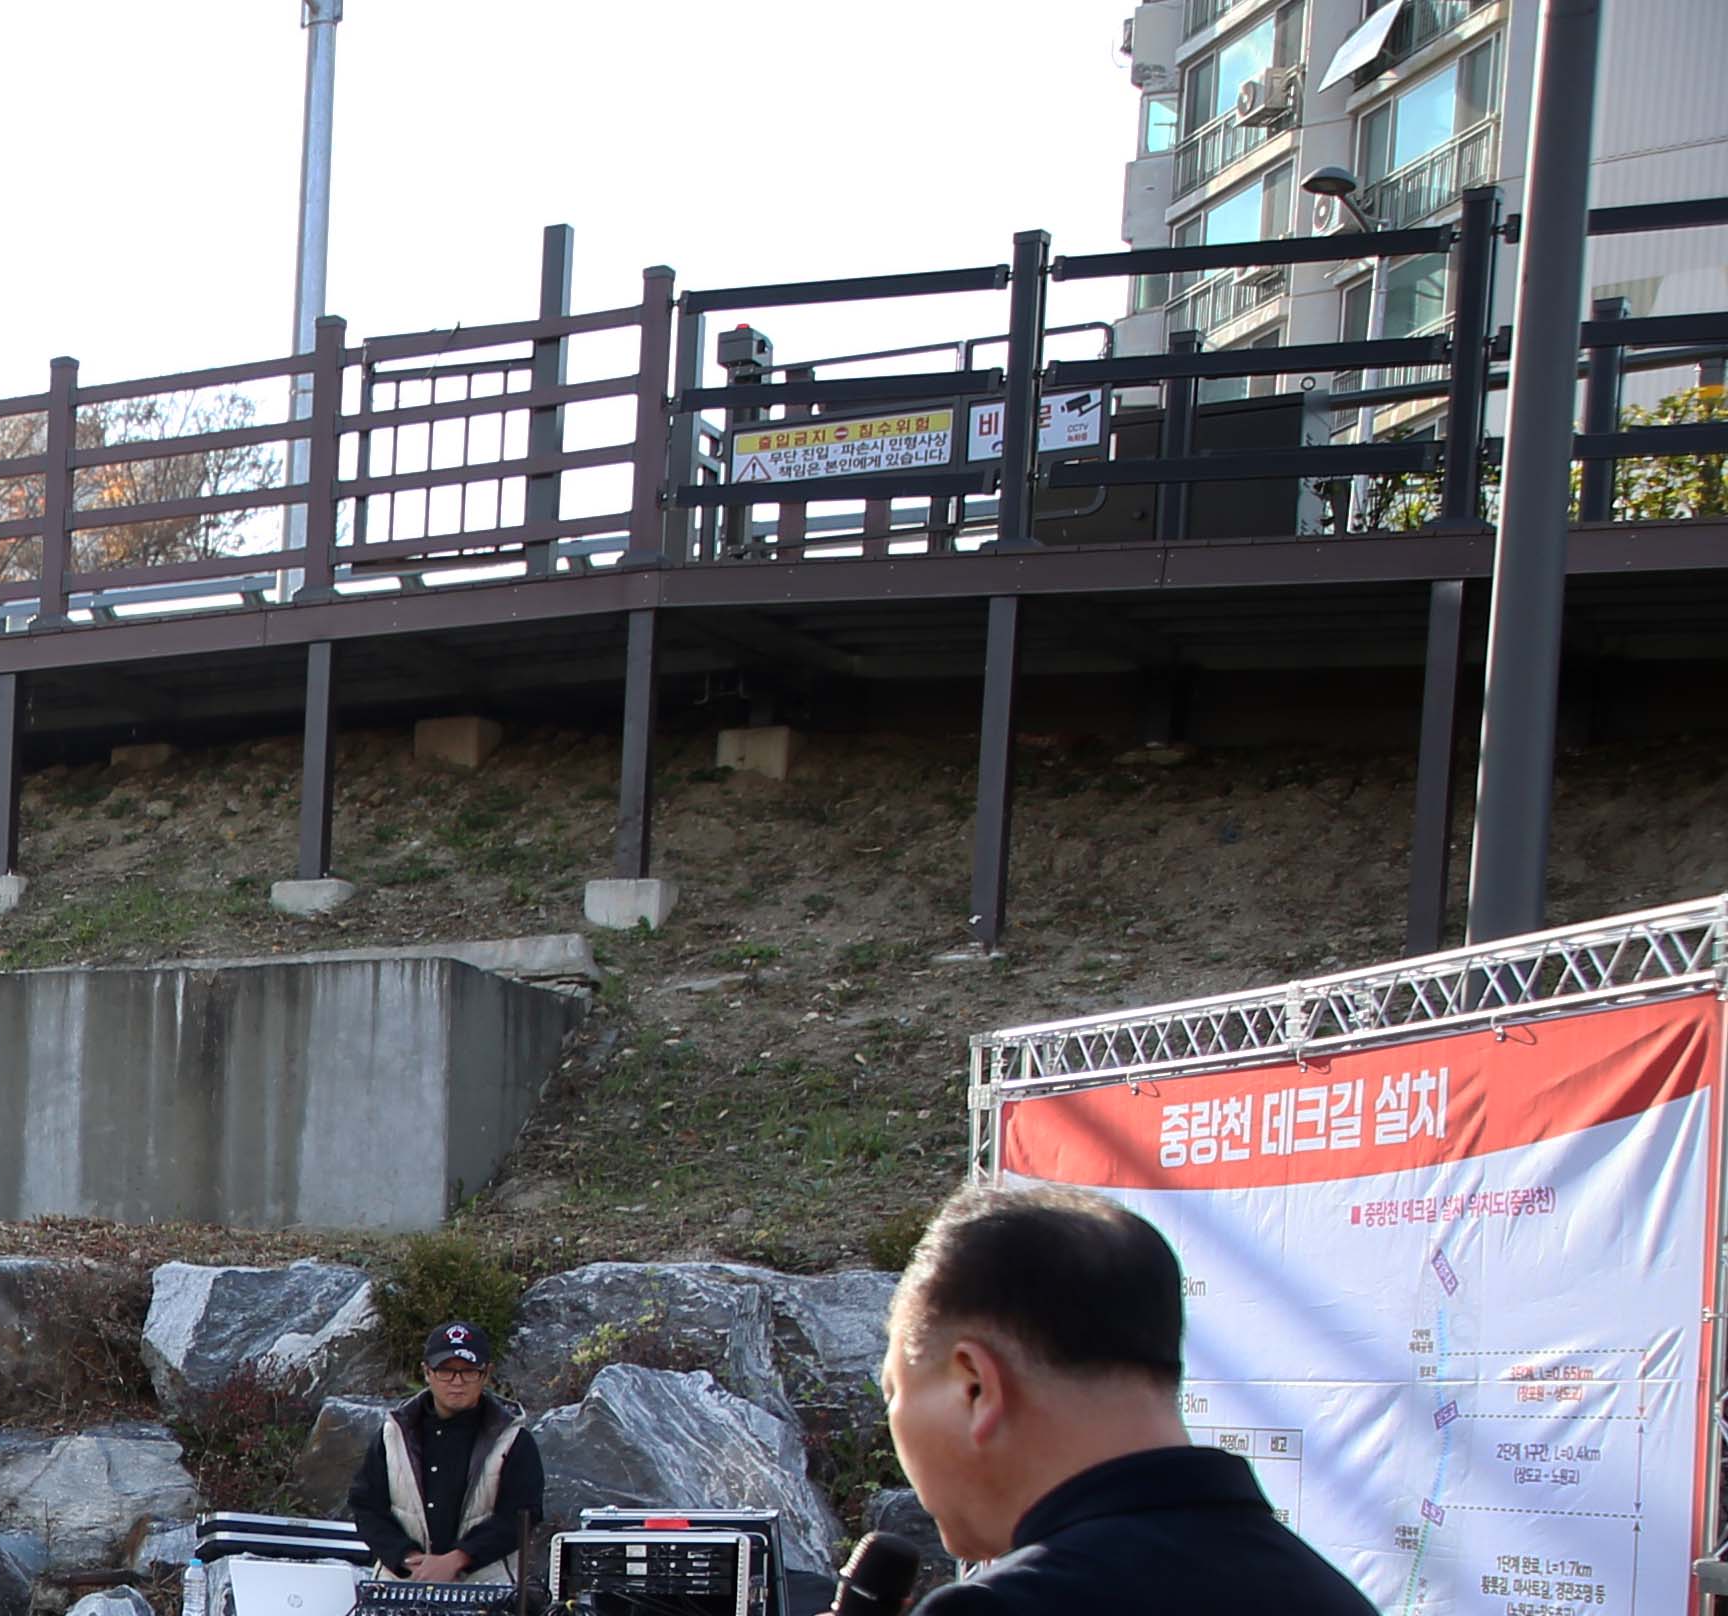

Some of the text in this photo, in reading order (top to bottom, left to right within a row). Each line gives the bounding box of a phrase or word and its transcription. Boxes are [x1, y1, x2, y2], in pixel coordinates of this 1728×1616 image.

[758, 416, 931, 450] 출입금지 침수위험
[1067, 423, 1089, 433] CCTV
[769, 450, 797, 464] 무단
[801, 446, 829, 461] 진입
[840, 440, 885, 457] 파손시
[888, 433, 948, 452] 민형사상
[778, 450, 947, 478] 책임은 본인에게 있습니다.
[1160, 1067, 1448, 1168] 중랑천 데크길 설치
[1364, 1201, 1399, 1227] 중랑천
[1402, 1199, 1437, 1223] 데크길
[1440, 1194, 1464, 1221] 설치
[1182, 1276, 1207, 1297] 3km
[1496, 1443, 1521, 1461] 2단계
[1554, 1446, 1601, 1461] L=0.4km
[1497, 1556, 1520, 1573] 1단계
[1546, 1560, 1592, 1577] L=1.7km
[1513, 1580, 1552, 1600] 마사토길,
[1556, 1582, 1593, 1603] 경관조명
[1595, 1585, 1606, 1605] 등
